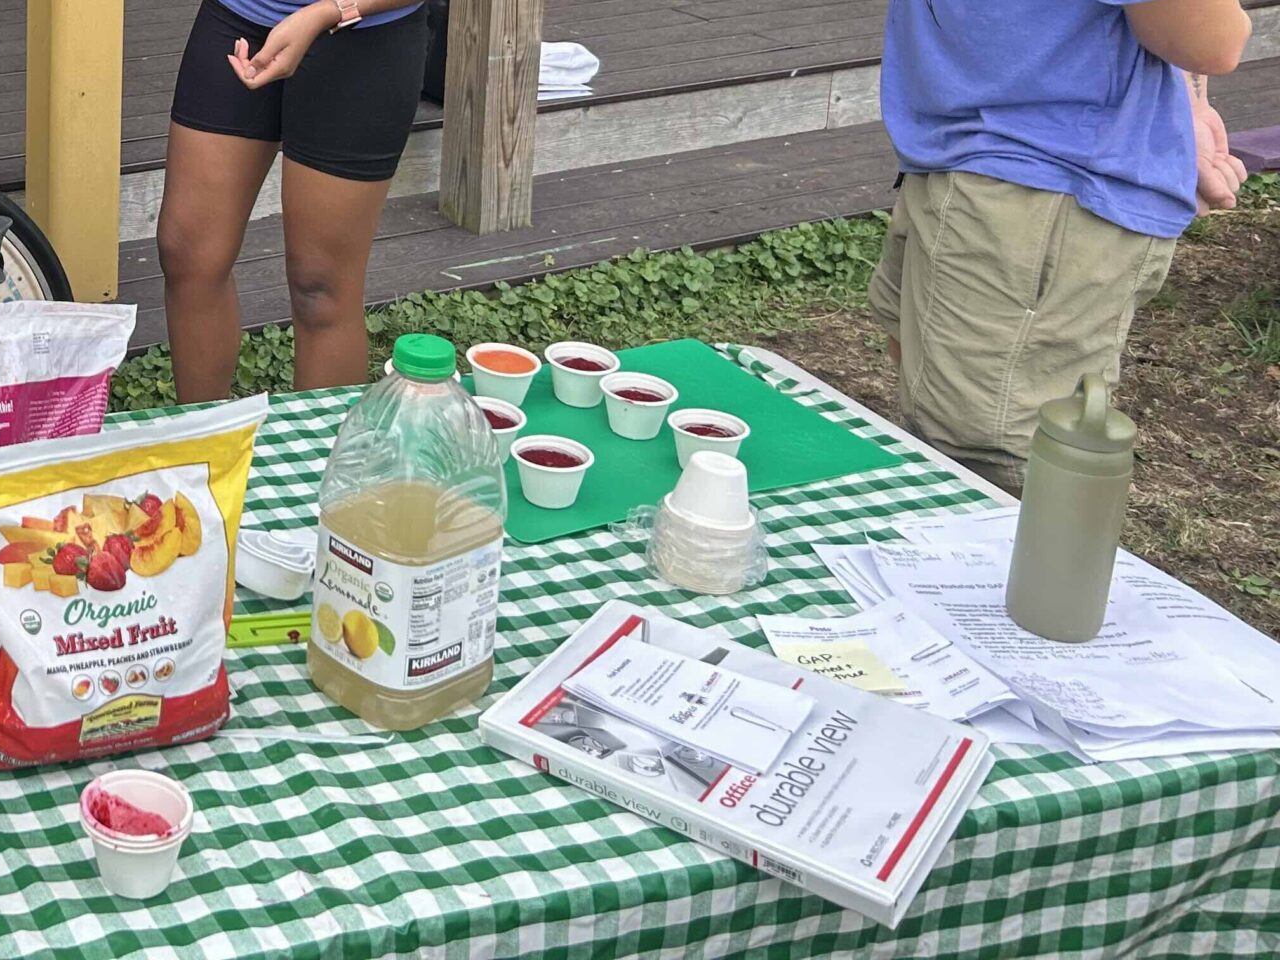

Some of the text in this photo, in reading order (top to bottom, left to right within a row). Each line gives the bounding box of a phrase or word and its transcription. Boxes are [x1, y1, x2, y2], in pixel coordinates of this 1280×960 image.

[330, 538, 372, 569] KIRKLAND
[319, 561, 383, 617] Lemonade
[329, 560, 371, 592] Organic
[63, 590, 158, 628] Organic
[52, 615, 179, 657] Mixed Fruit
[70, 659, 107, 672] PINEAPPLE,
[107, 654, 136, 667] PEACHES
[136, 651, 150, 662] AND
[411, 644, 461, 670] KIRKLAND
[797, 653, 833, 665] GAP
[832, 669, 868, 681] true
[719, 773, 758, 810] Office
[750, 755, 826, 828] durable
[806, 709, 859, 755] view
[558, 767, 662, 821] durable view
